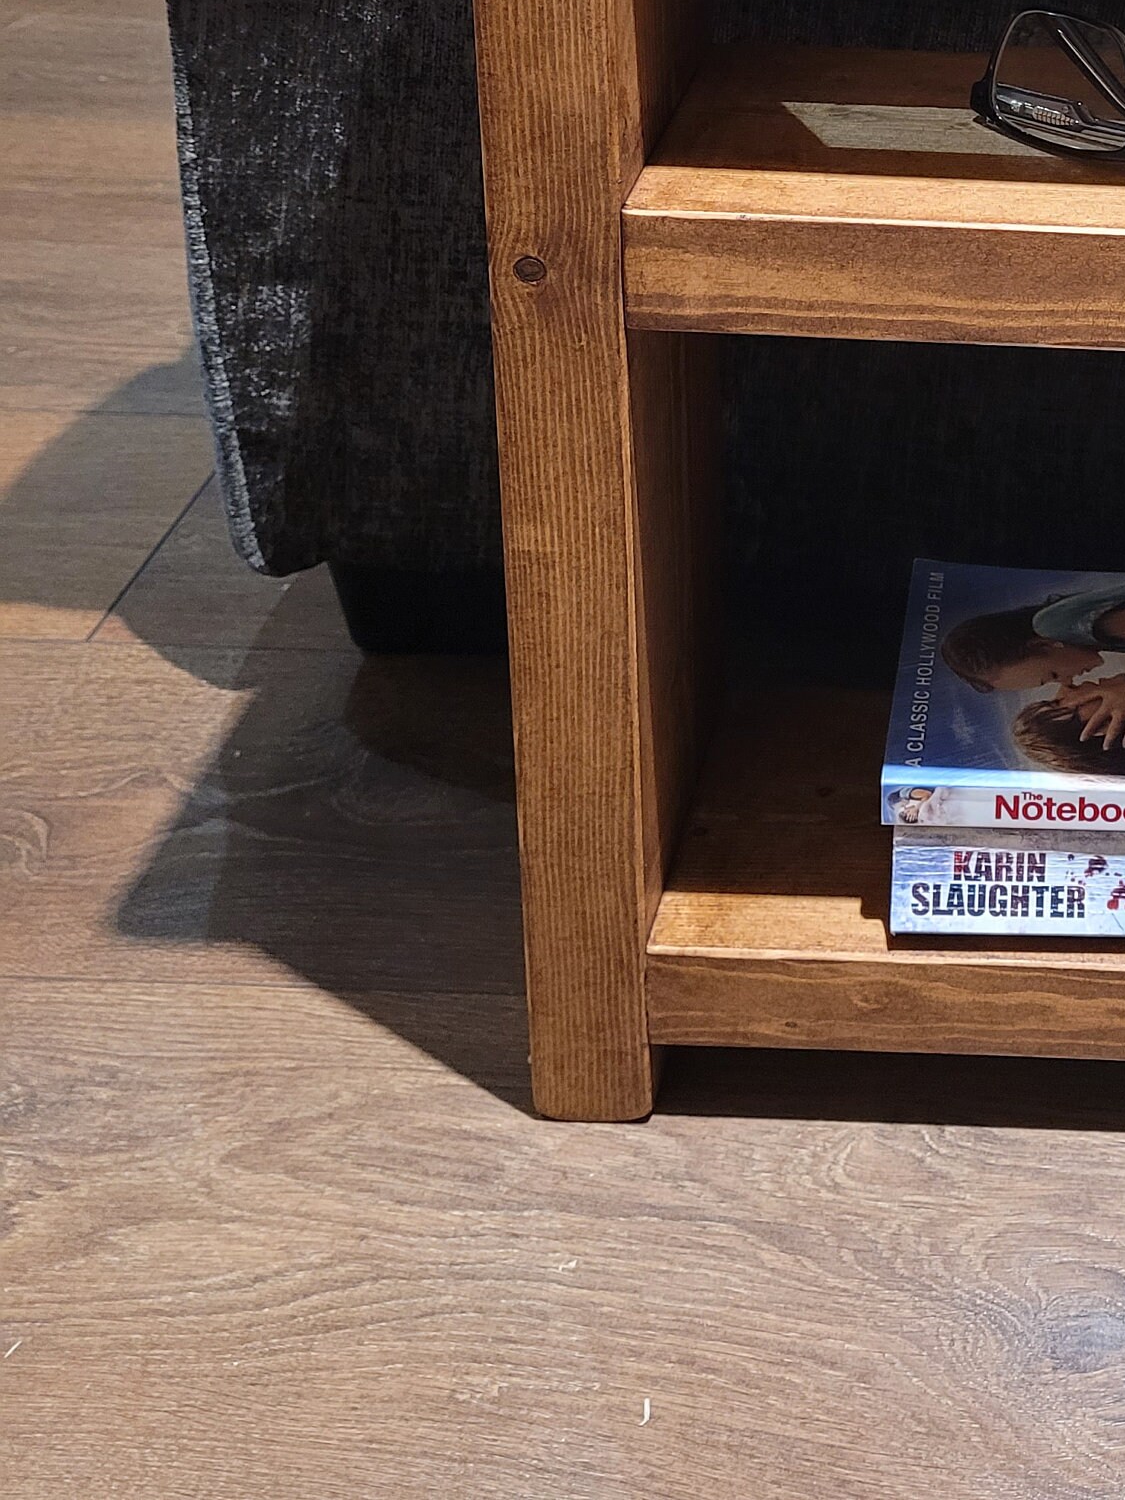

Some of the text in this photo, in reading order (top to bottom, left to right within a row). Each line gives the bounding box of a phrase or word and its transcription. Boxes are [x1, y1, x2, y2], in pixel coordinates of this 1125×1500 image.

[905, 572, 945, 768] A CLASSIC HOLLYWOOD FILM
[1022, 791, 1043, 801] The
[953, 851, 1046, 882] KARIN
[911, 882, 1086, 918] SLAUGHTER
